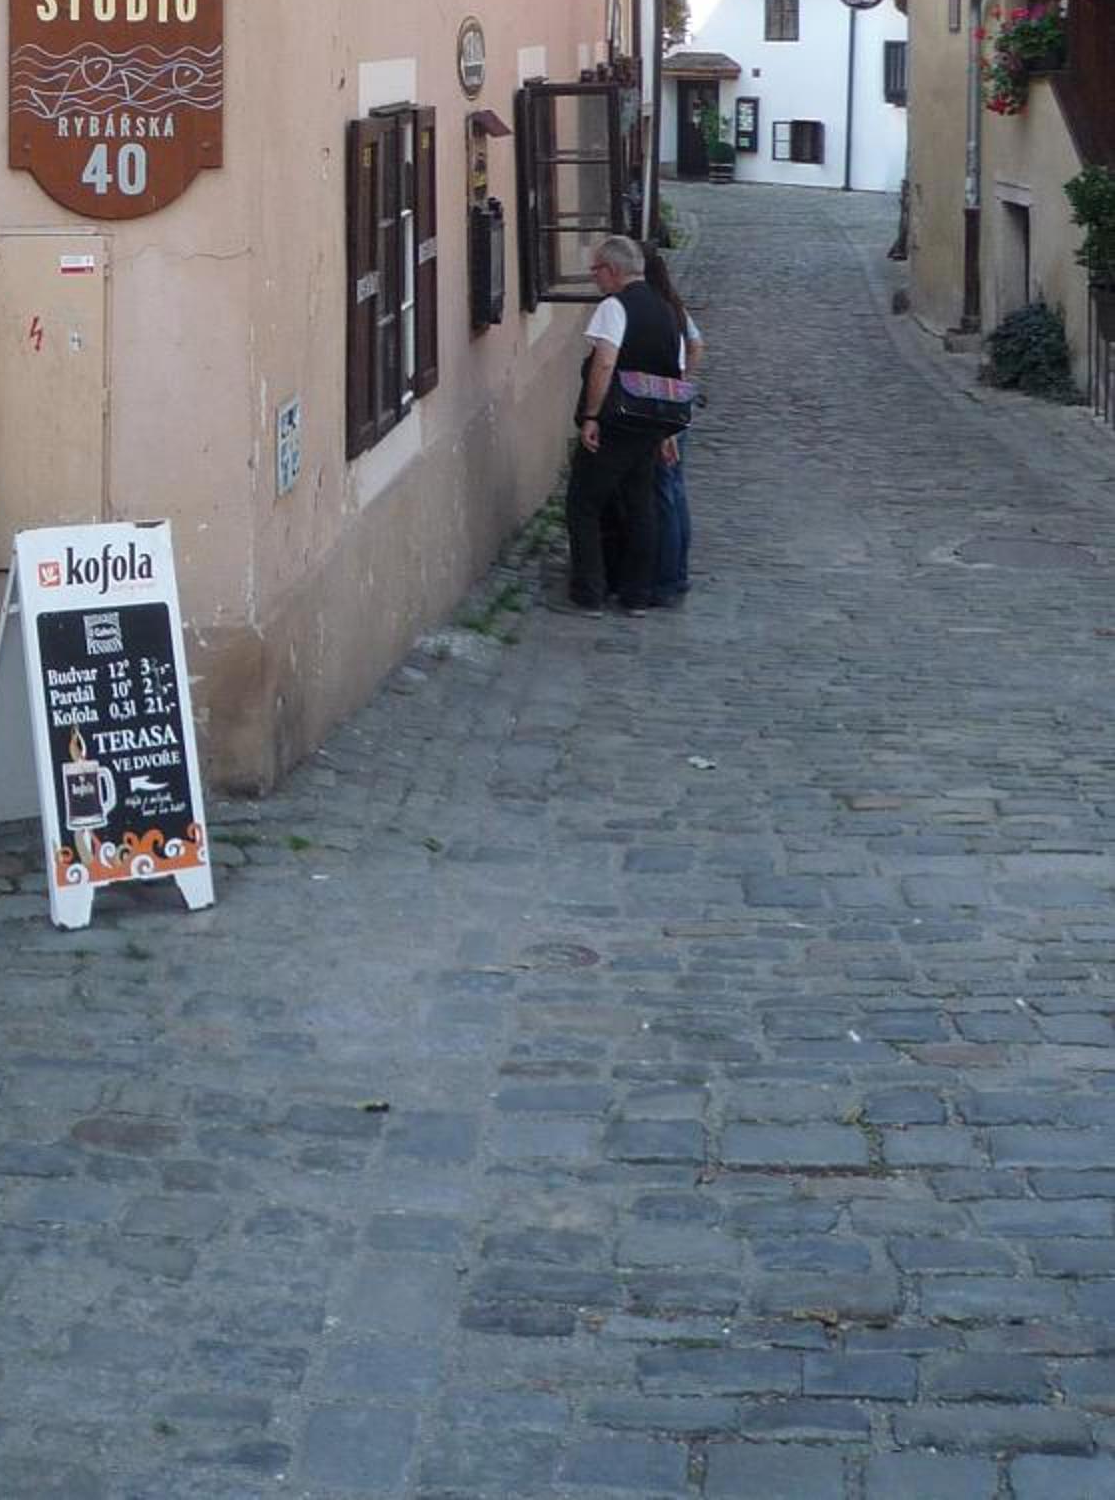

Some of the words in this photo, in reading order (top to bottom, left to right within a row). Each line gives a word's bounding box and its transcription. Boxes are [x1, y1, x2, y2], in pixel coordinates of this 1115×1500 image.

[58, 112, 175, 138] RYBÁŘSKÁ
[82, 143, 148, 195] 40
[65, 542, 154, 595] kofola
[47, 666, 98, 687] Budvar
[52, 705, 100, 728] Kofola
[92, 723, 179, 755] TERASA
